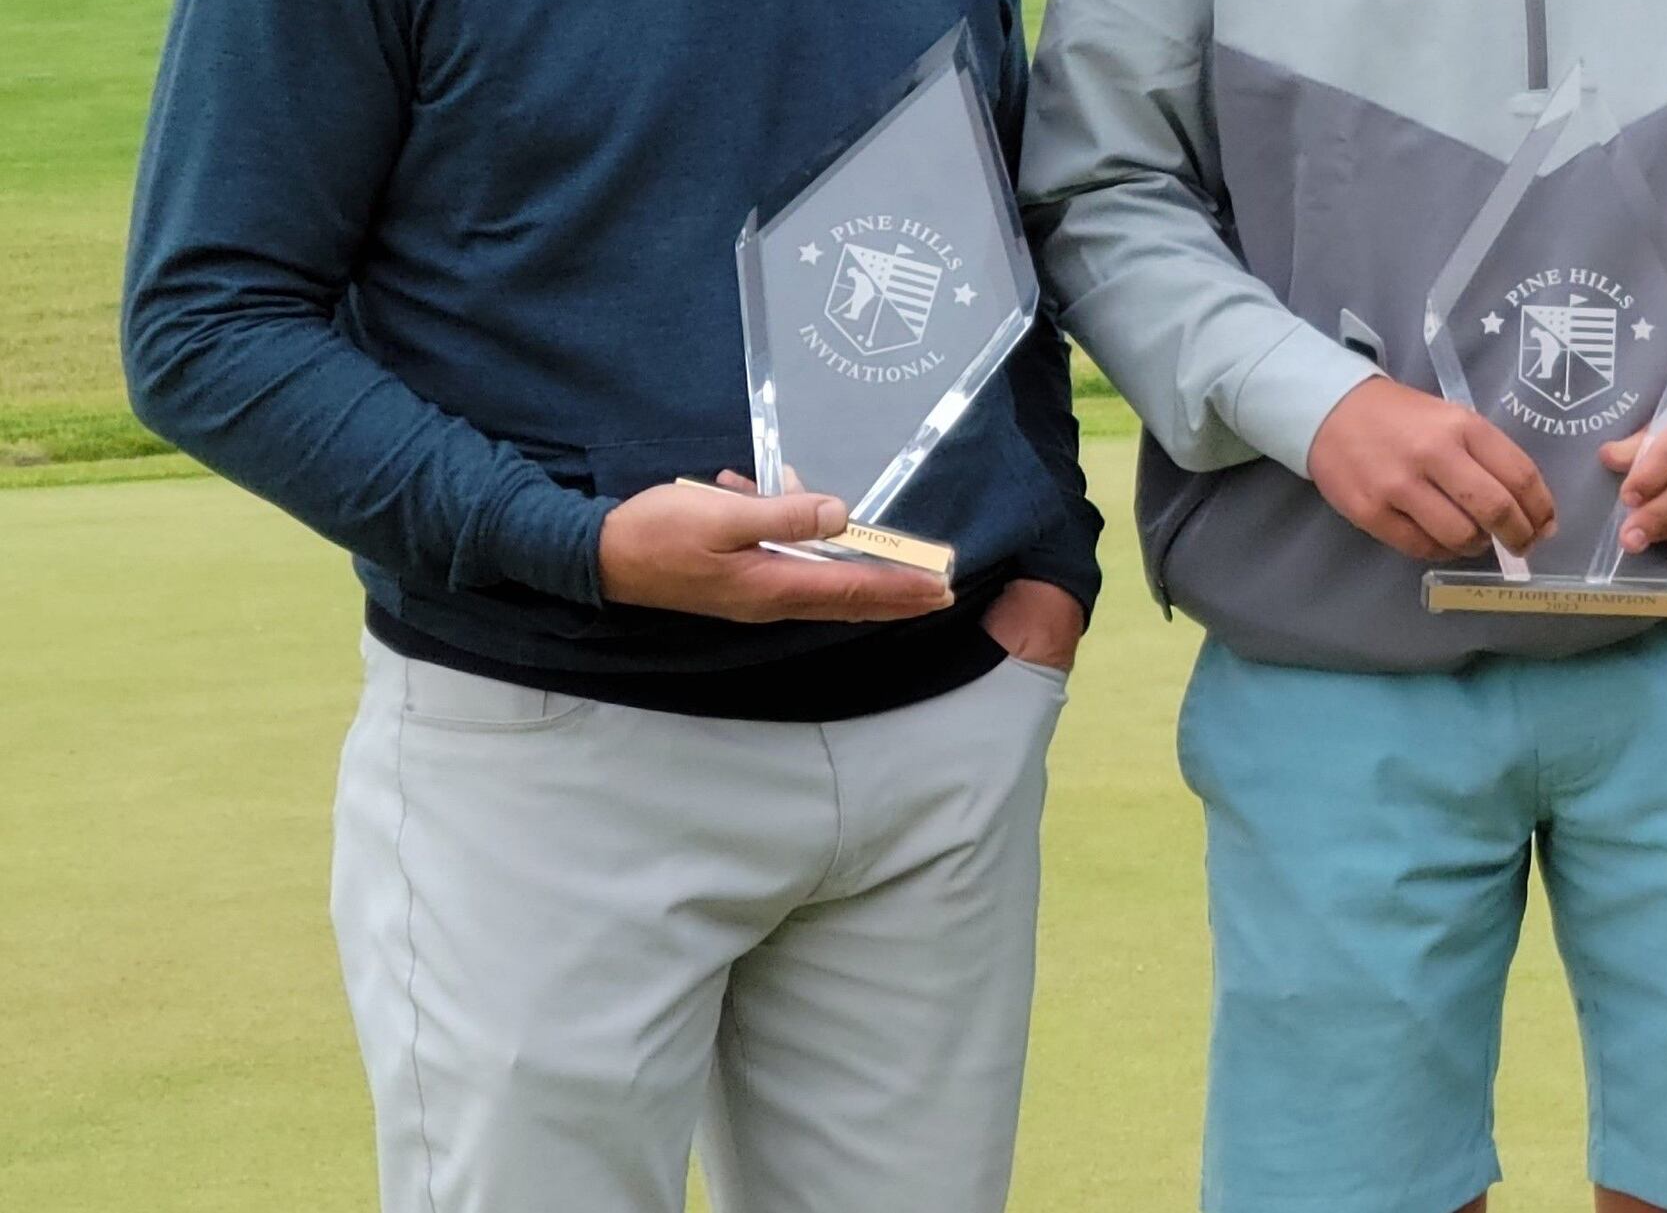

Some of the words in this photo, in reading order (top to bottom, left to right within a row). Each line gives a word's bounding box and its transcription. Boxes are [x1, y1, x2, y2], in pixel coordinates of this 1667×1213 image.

[830, 215, 893, 243] PINE
[900, 219, 963, 271] HILLS
[1504, 268, 1562, 307] PINE
[1569, 268, 1635, 309] HILLS
[800, 324, 945, 383] INVITATIONAL
[1501, 391, 1640, 436] INVITATIONAL
[1498, 589, 1559, 602] FLIGHT
[1565, 591, 1657, 605] CHAMPION
